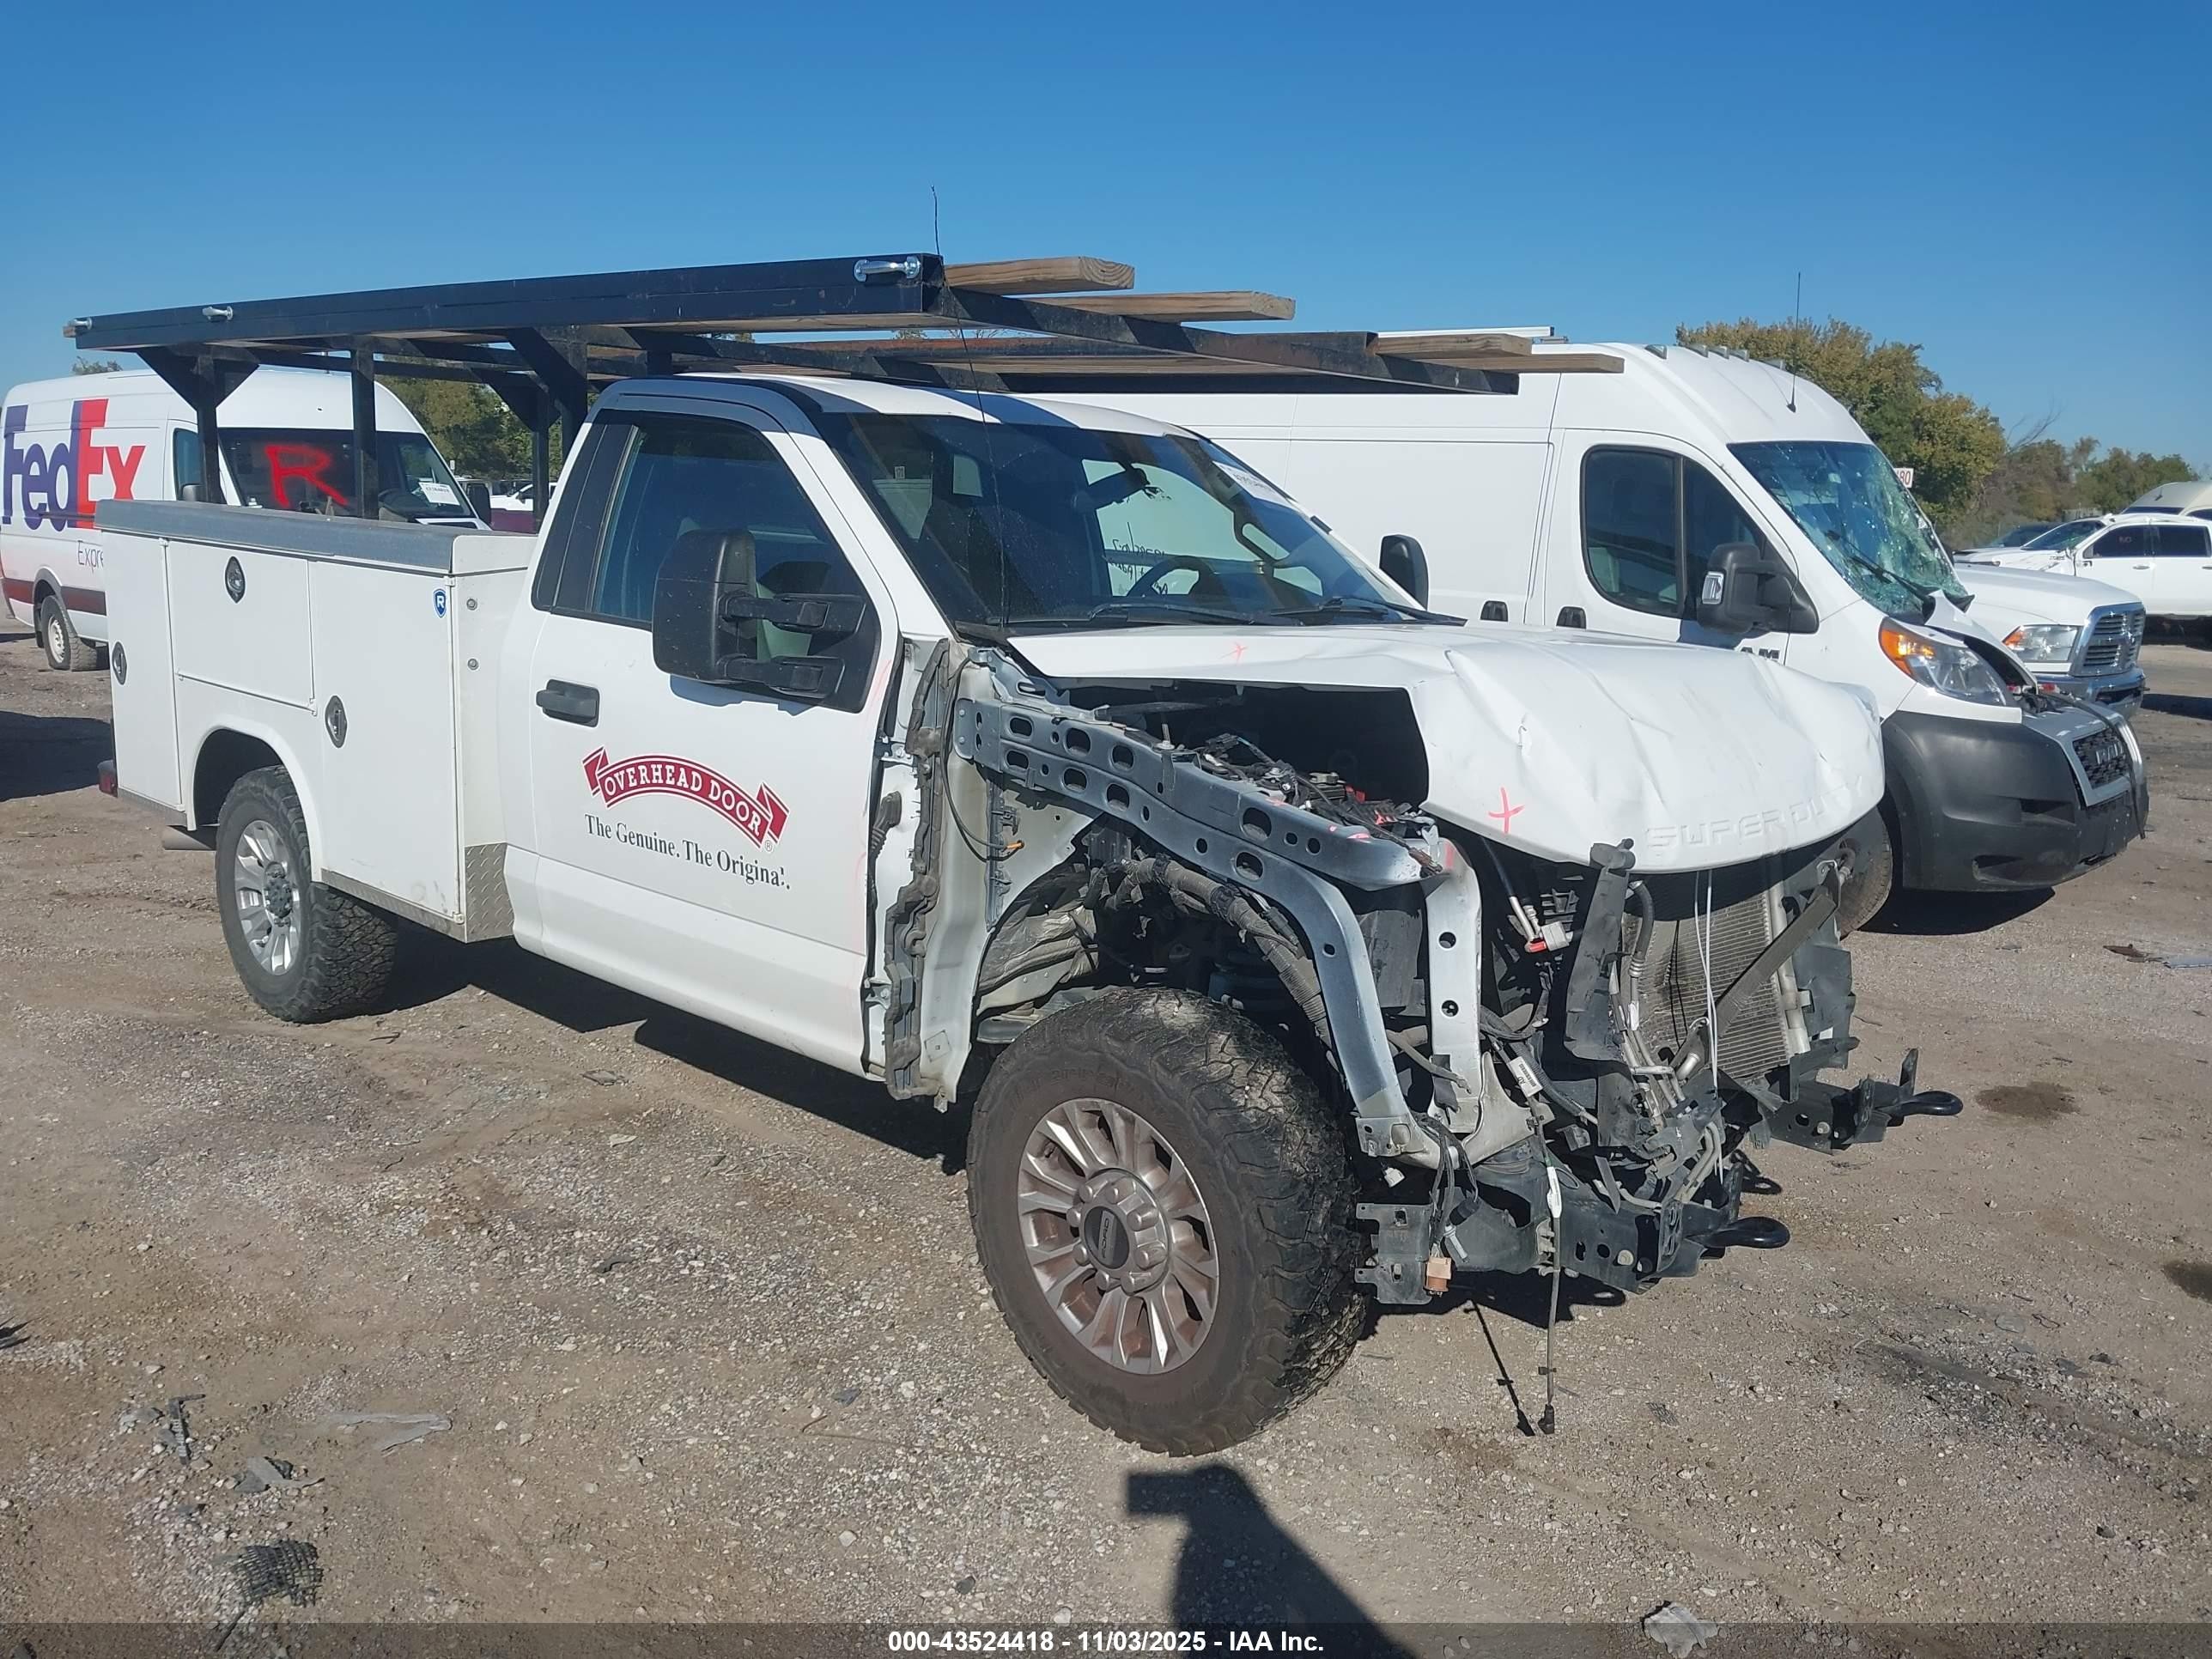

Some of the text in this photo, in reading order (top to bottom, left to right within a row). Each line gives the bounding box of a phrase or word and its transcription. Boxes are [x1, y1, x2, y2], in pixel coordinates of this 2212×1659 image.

[3, 398, 146, 532] FedEx
[265, 443, 348, 508] R
[436, 595, 445, 609] R
[604, 763, 762, 836] OVERHEAD DOOR
[1645, 809, 1787, 848] SUPER
[585, 813, 612, 840] The
[616, 822, 680, 859] Genuine.
[682, 839, 713, 867] The
